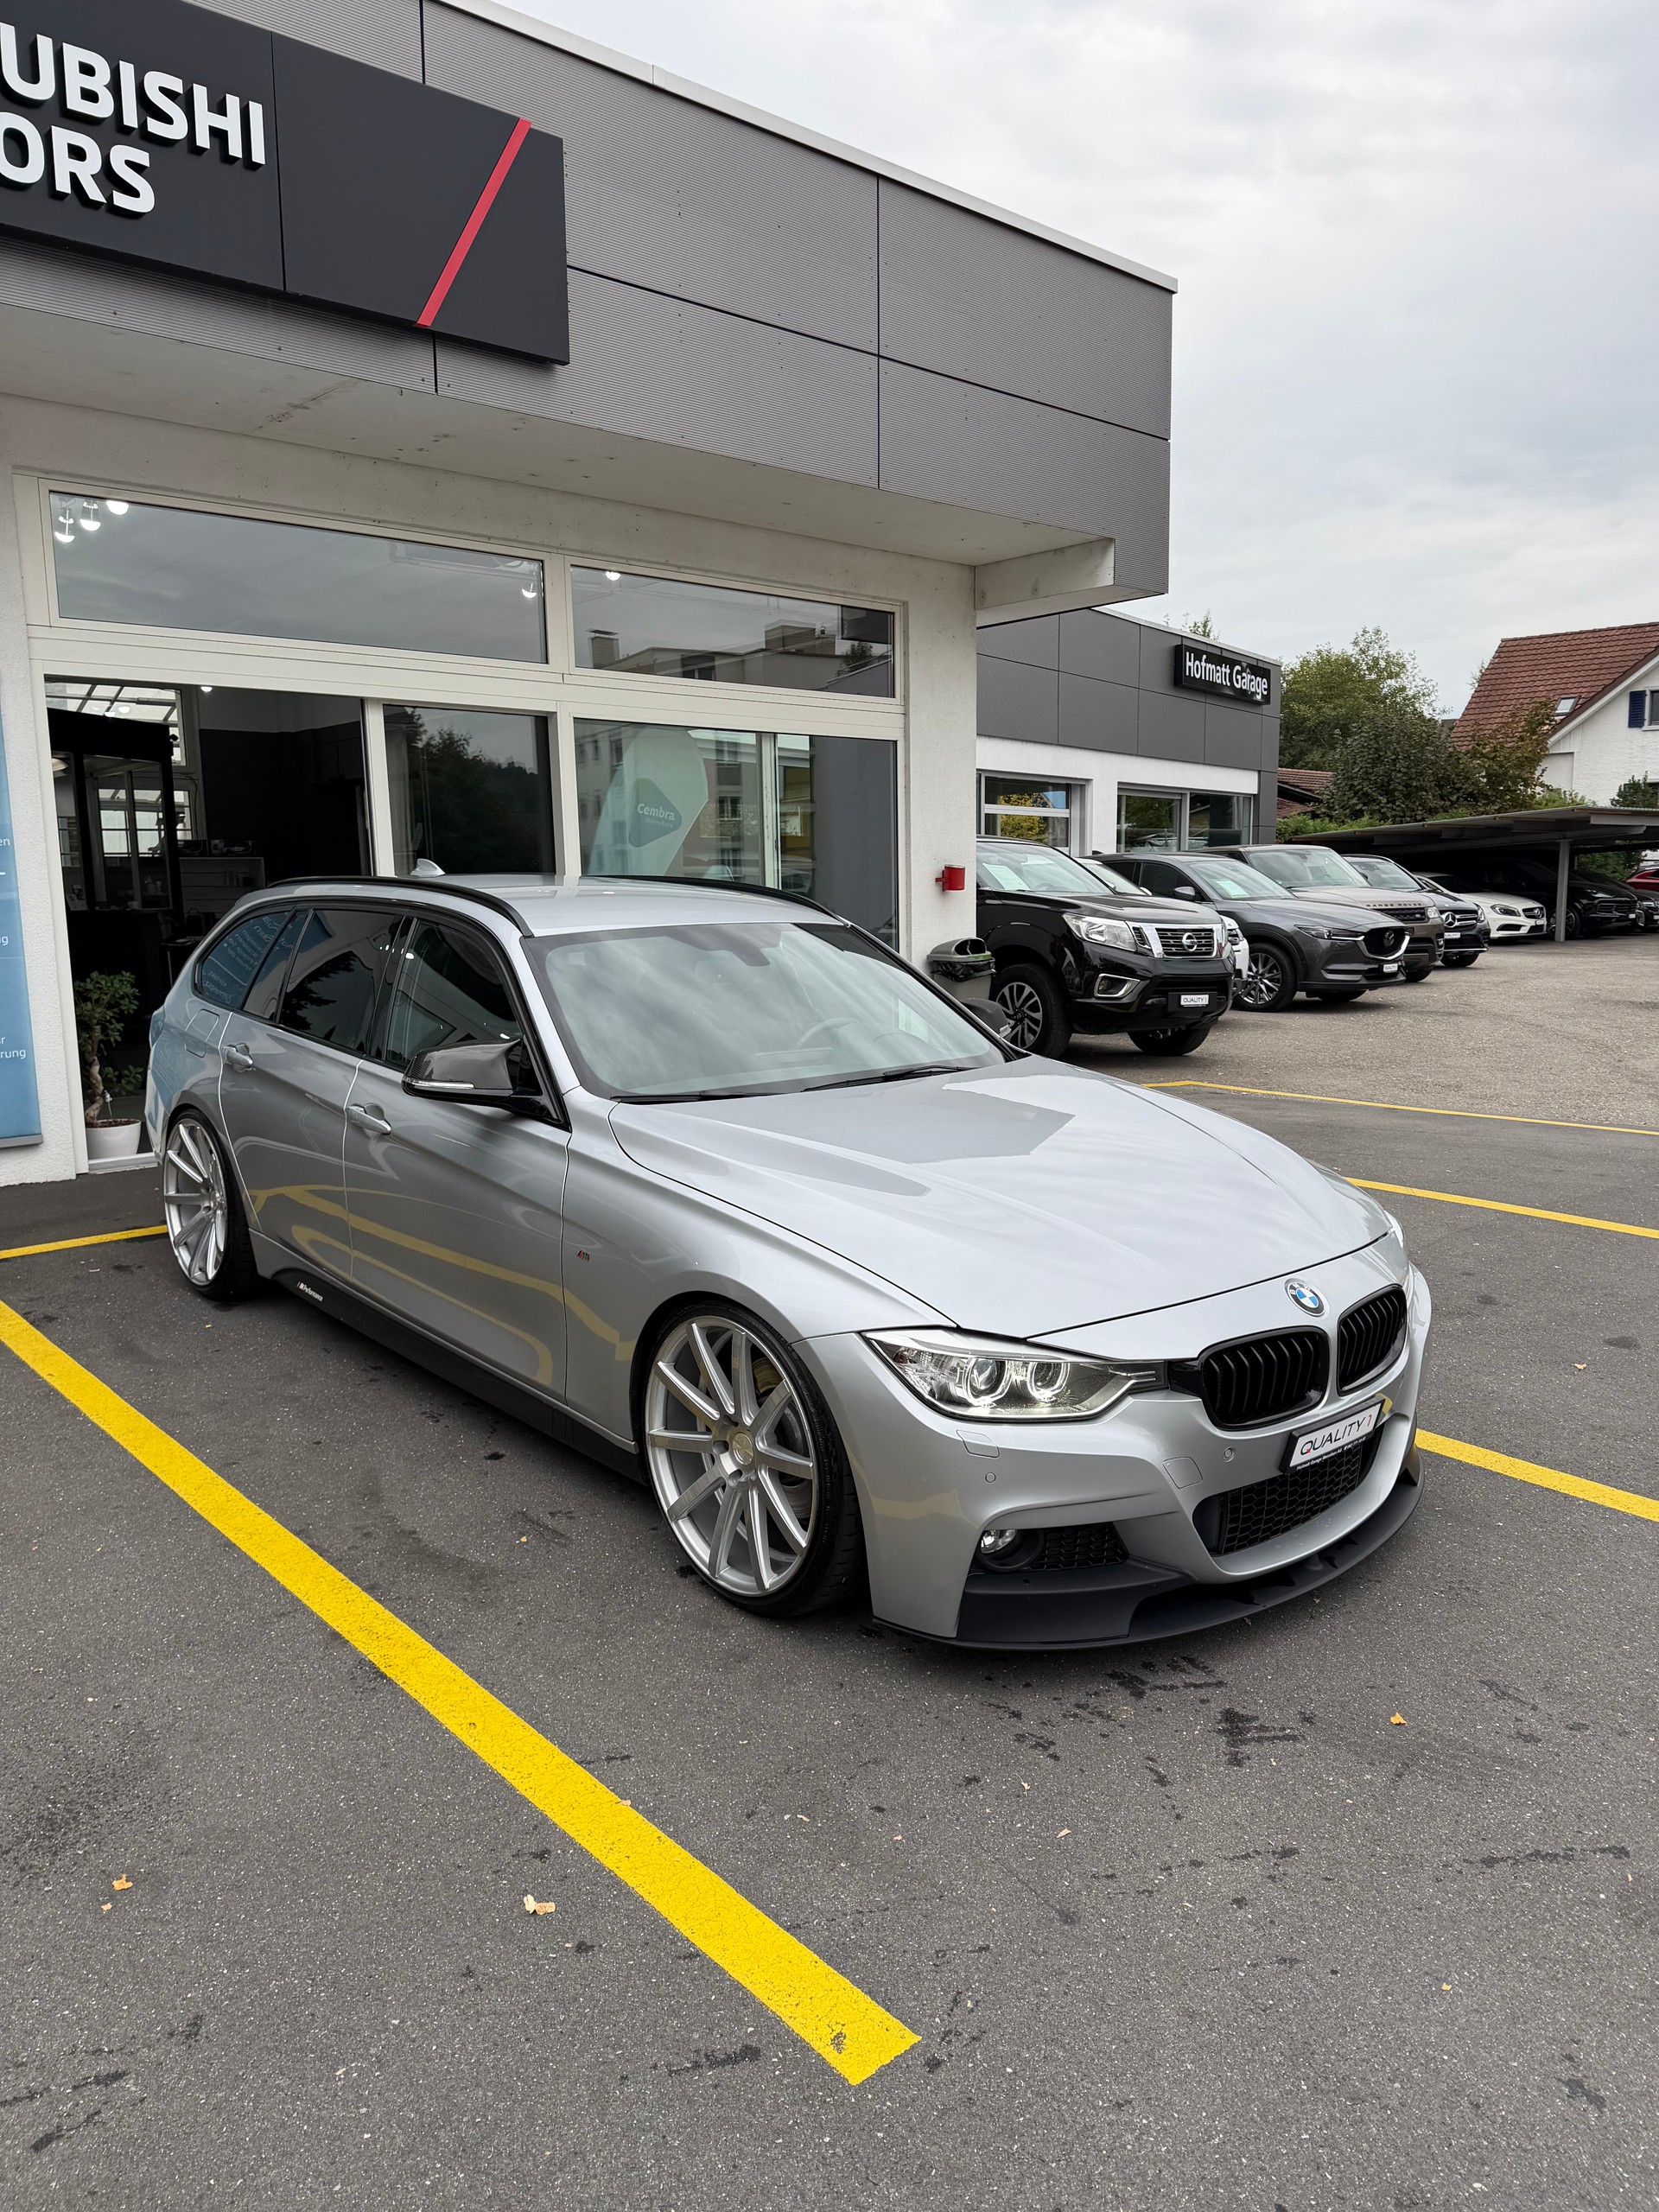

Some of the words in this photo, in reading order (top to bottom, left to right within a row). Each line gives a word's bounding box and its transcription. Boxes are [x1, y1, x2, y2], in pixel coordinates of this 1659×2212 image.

[0, 22, 265, 165] UBISHI
[0, 112, 155, 213] ORS
[1185, 652, 1230, 686] Hofmatt
[1232, 665, 1268, 700] Garage
[637, 804, 675, 821] Cembra
[1300, 1416, 1366, 1456] QUALITY
[1368, 1414, 1373, 1427] 1
